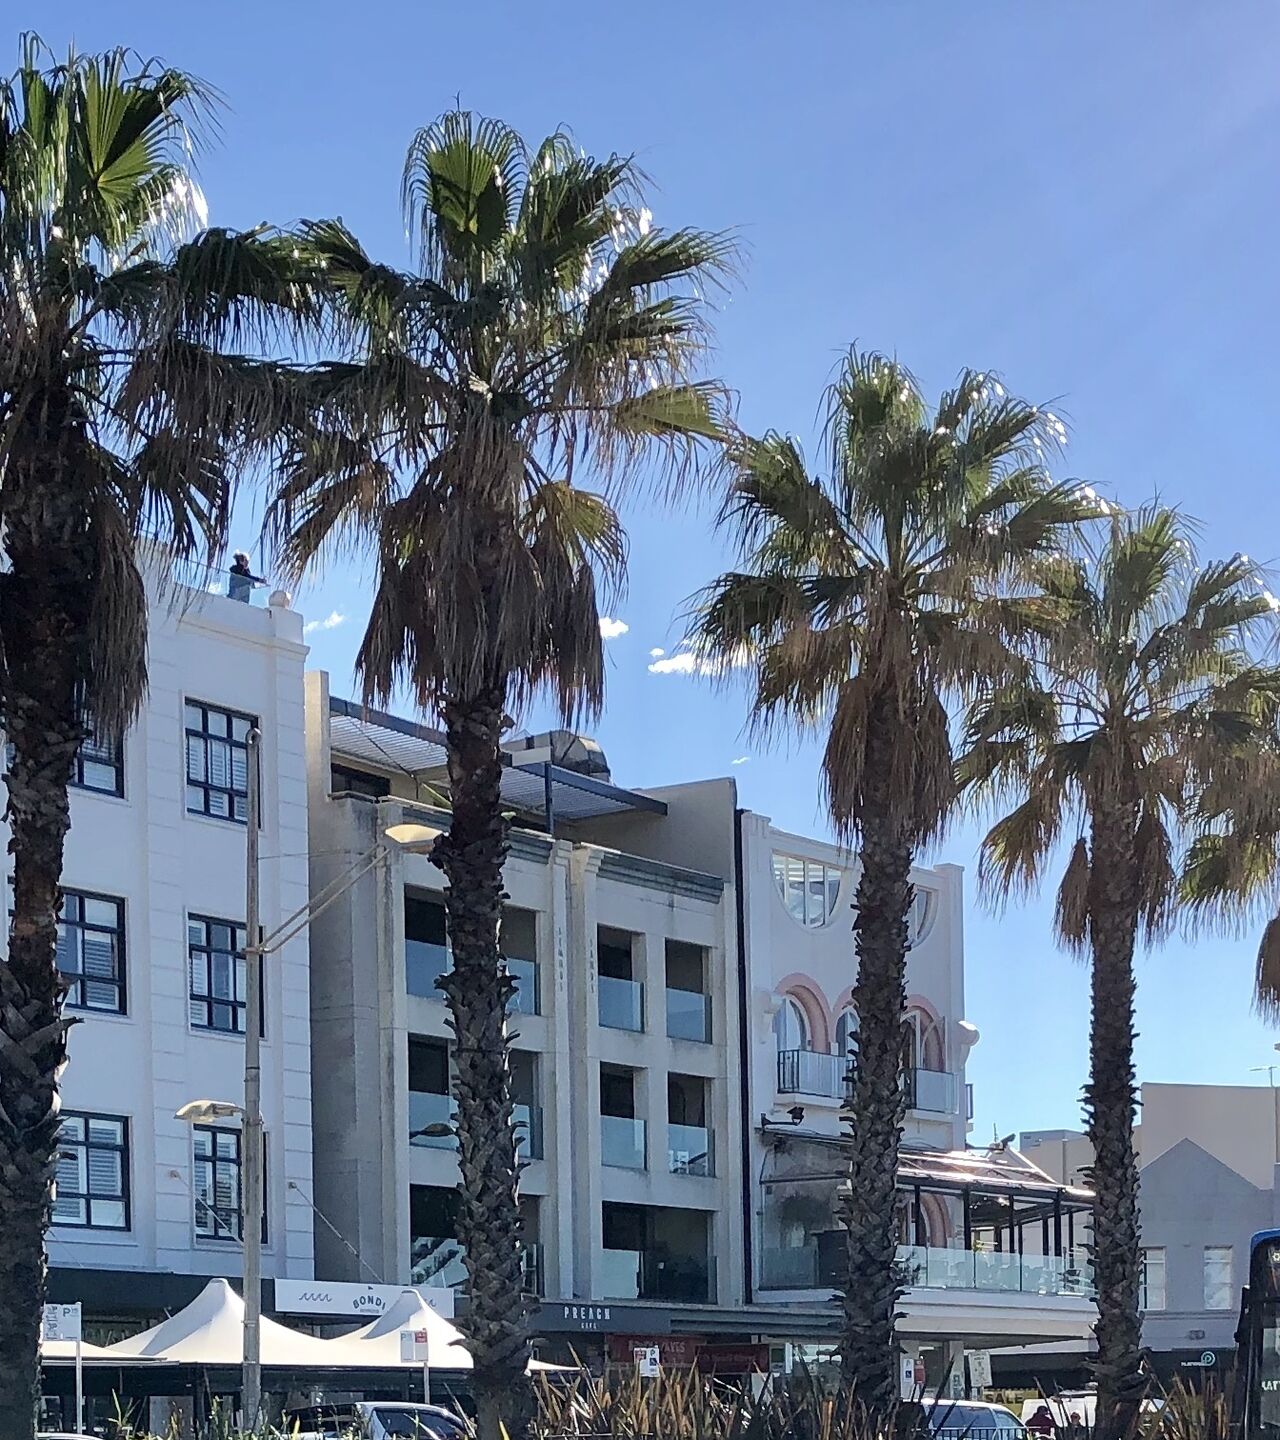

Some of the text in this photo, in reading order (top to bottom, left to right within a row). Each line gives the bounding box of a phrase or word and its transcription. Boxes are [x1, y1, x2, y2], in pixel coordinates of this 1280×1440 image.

[352, 1295, 386, 1311] BONDI
[564, 1306, 611, 1320] PREACH
[985, 1391, 1025, 1404] SALE
